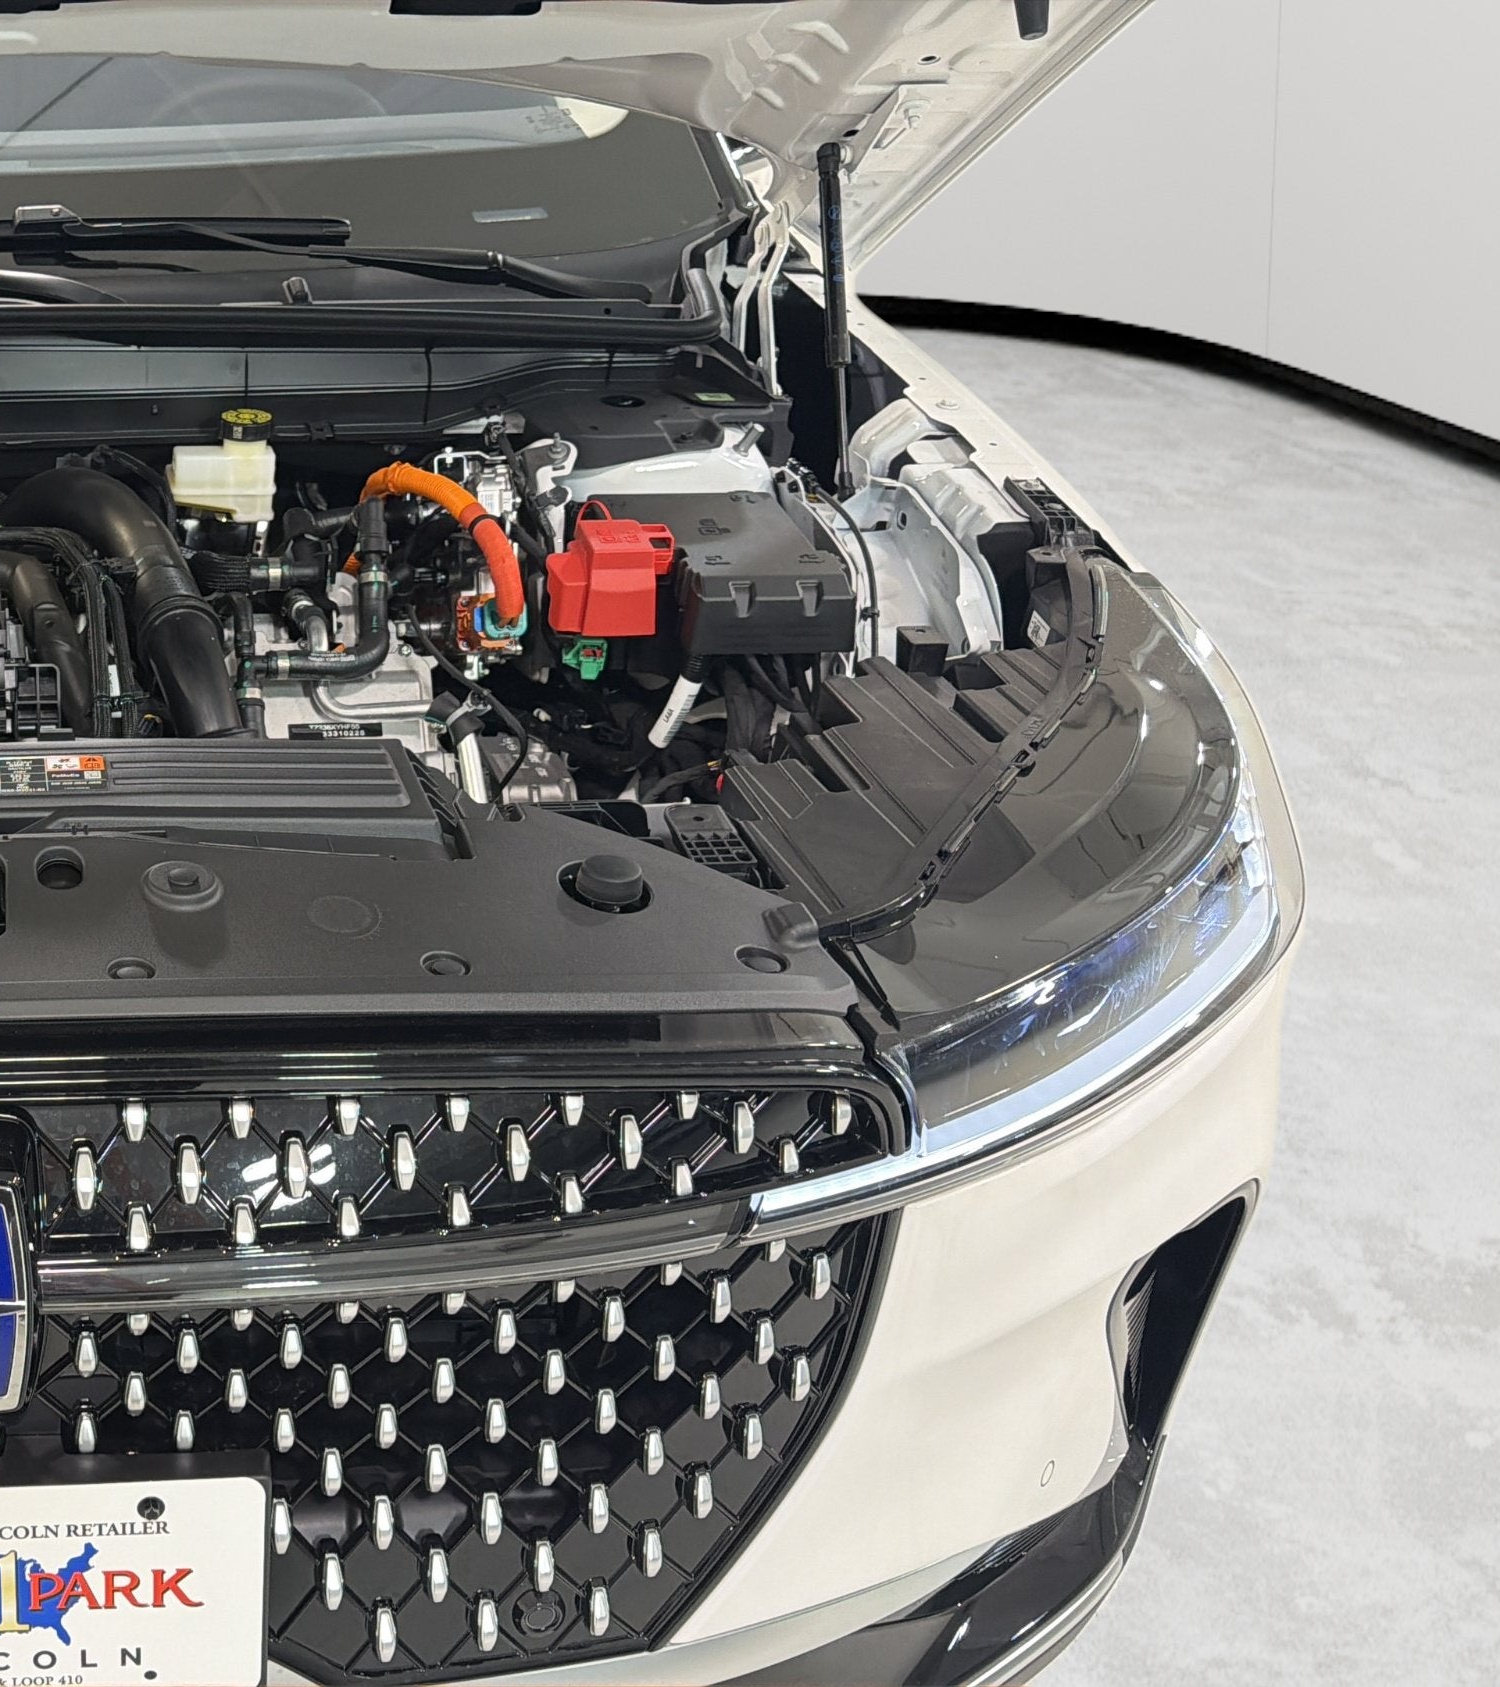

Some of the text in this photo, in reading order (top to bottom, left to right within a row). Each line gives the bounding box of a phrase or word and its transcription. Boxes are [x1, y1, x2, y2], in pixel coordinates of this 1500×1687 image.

[65, 1521, 170, 1538] RETAILER
[28, 1568, 204, 1611] PARK
[12, 1676, 55, 1686] LOOP
[58, 1675, 83, 1685] 410
